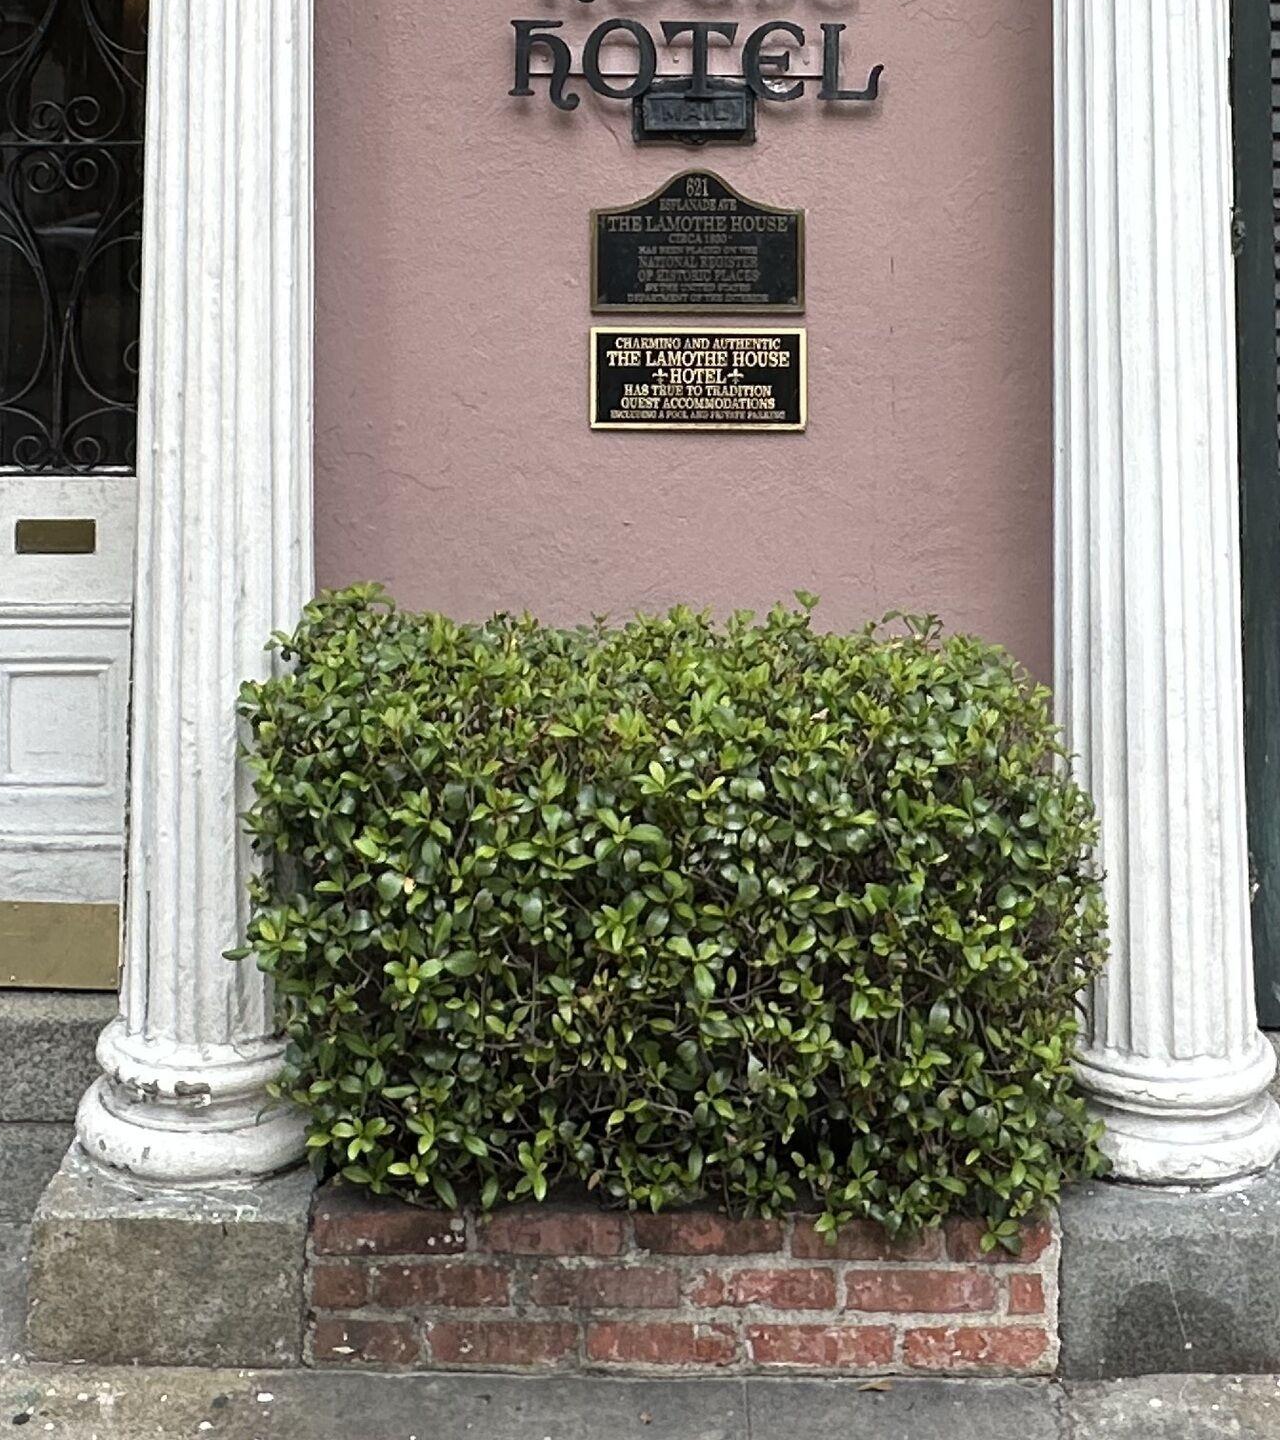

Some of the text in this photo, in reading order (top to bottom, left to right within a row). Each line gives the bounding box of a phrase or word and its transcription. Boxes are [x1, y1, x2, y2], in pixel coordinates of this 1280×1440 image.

[508, 18, 884, 111] HOTEL
[686, 178, 709, 197] 621
[660, 198, 737, 211] ESPLANADE AVE
[608, 216, 788, 232] THE LAMOTHE HOUSE
[669, 233, 703, 244] CIRCA
[638, 256, 758, 269] NATIONAL REGISTER
[638, 269, 761, 281] OF HISTORIC PLACES
[615, 337, 781, 350] CHARMING AND AUTHENTIC
[607, 351, 790, 367] THE LAMOTHE HOUSE
[670, 368, 727, 384] HOTEL
[624, 385, 772, 396] HAS TRUE TO TRADITION
[621, 398, 775, 409] GUEST ACCOMMODATIONS
